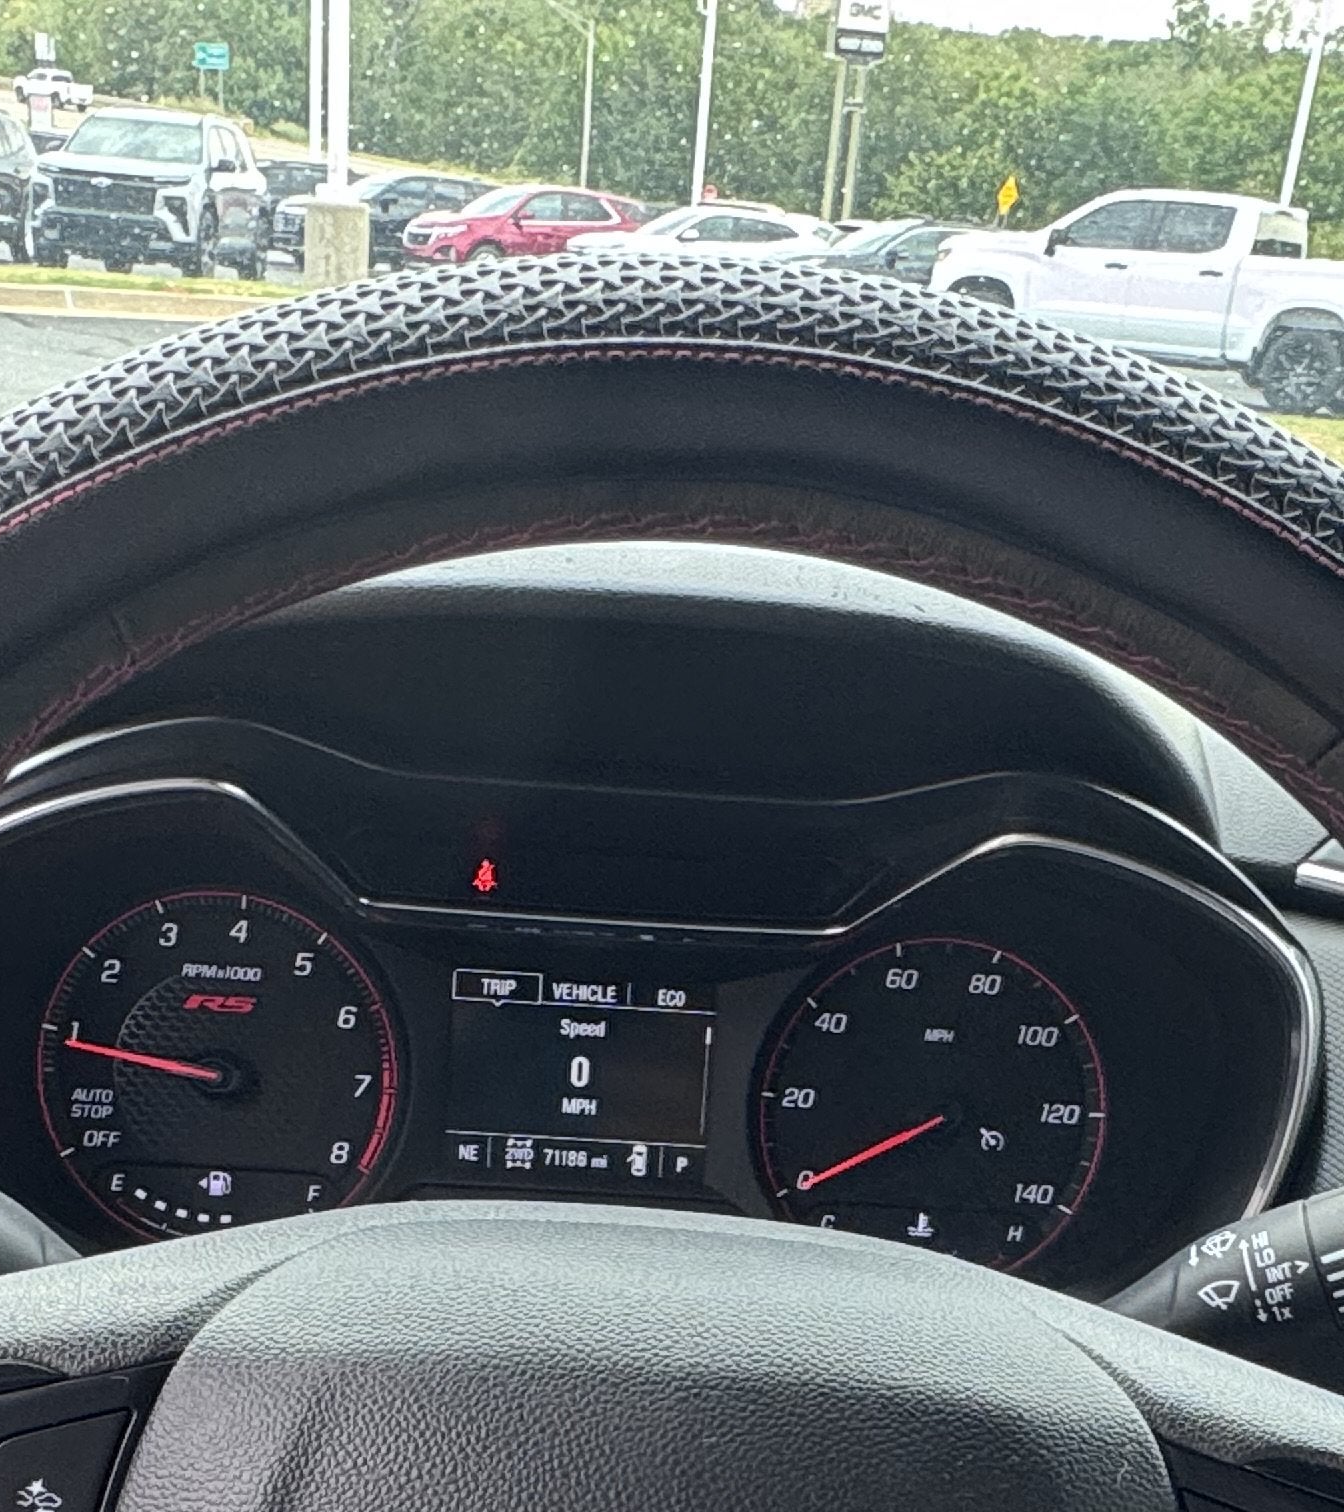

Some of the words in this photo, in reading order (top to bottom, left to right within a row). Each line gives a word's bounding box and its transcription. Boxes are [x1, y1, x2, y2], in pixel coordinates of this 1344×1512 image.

[158, 922, 178, 947] 3
[229, 919, 249, 944] 4
[100, 958, 122, 984] 2
[293, 952, 314, 977] 5
[480, 977, 518, 997] TRIP
[885, 968, 920, 990] 60
[968, 974, 1002, 996] 80
[552, 982, 618, 1003] VEHICLE
[657, 988, 686, 1008] ECO
[183, 994, 257, 1014] RS
[336, 1005, 358, 1030] 6
[559, 1018, 606, 1039] Speed
[813, 1012, 848, 1034] 40
[70, 1020, 80, 1041] 1
[923, 1028, 956, 1043] MPH
[1017, 1024, 1059, 1048] 100
[570, 1055, 590, 1088] 0
[70, 1088, 114, 1103] AUTO
[353, 1074, 372, 1098] 7
[561, 1097, 598, 1116] MPH
[781, 1087, 816, 1109] 20
[70, 1104, 114, 1119] STOP
[1040, 1103, 1081, 1125] 120
[82, 1130, 121, 1148] OFF
[329, 1141, 350, 1164] 8
[458, 1144, 480, 1162] NE
[676, 1156, 689, 1173] P
[110, 1173, 126, 1192] E
[796, 1169, 815, 1191] 0
[306, 1184, 322, 1202] F
[1014, 1183, 1054, 1205] 140
[1006, 1225, 1024, 1243] H
[1250, 1230, 1269, 1250] HI
[1254, 1247, 1276, 1268] LO
[1264, 1261, 1293, 1283] INT
[1264, 1283, 1295, 1306] OFF
